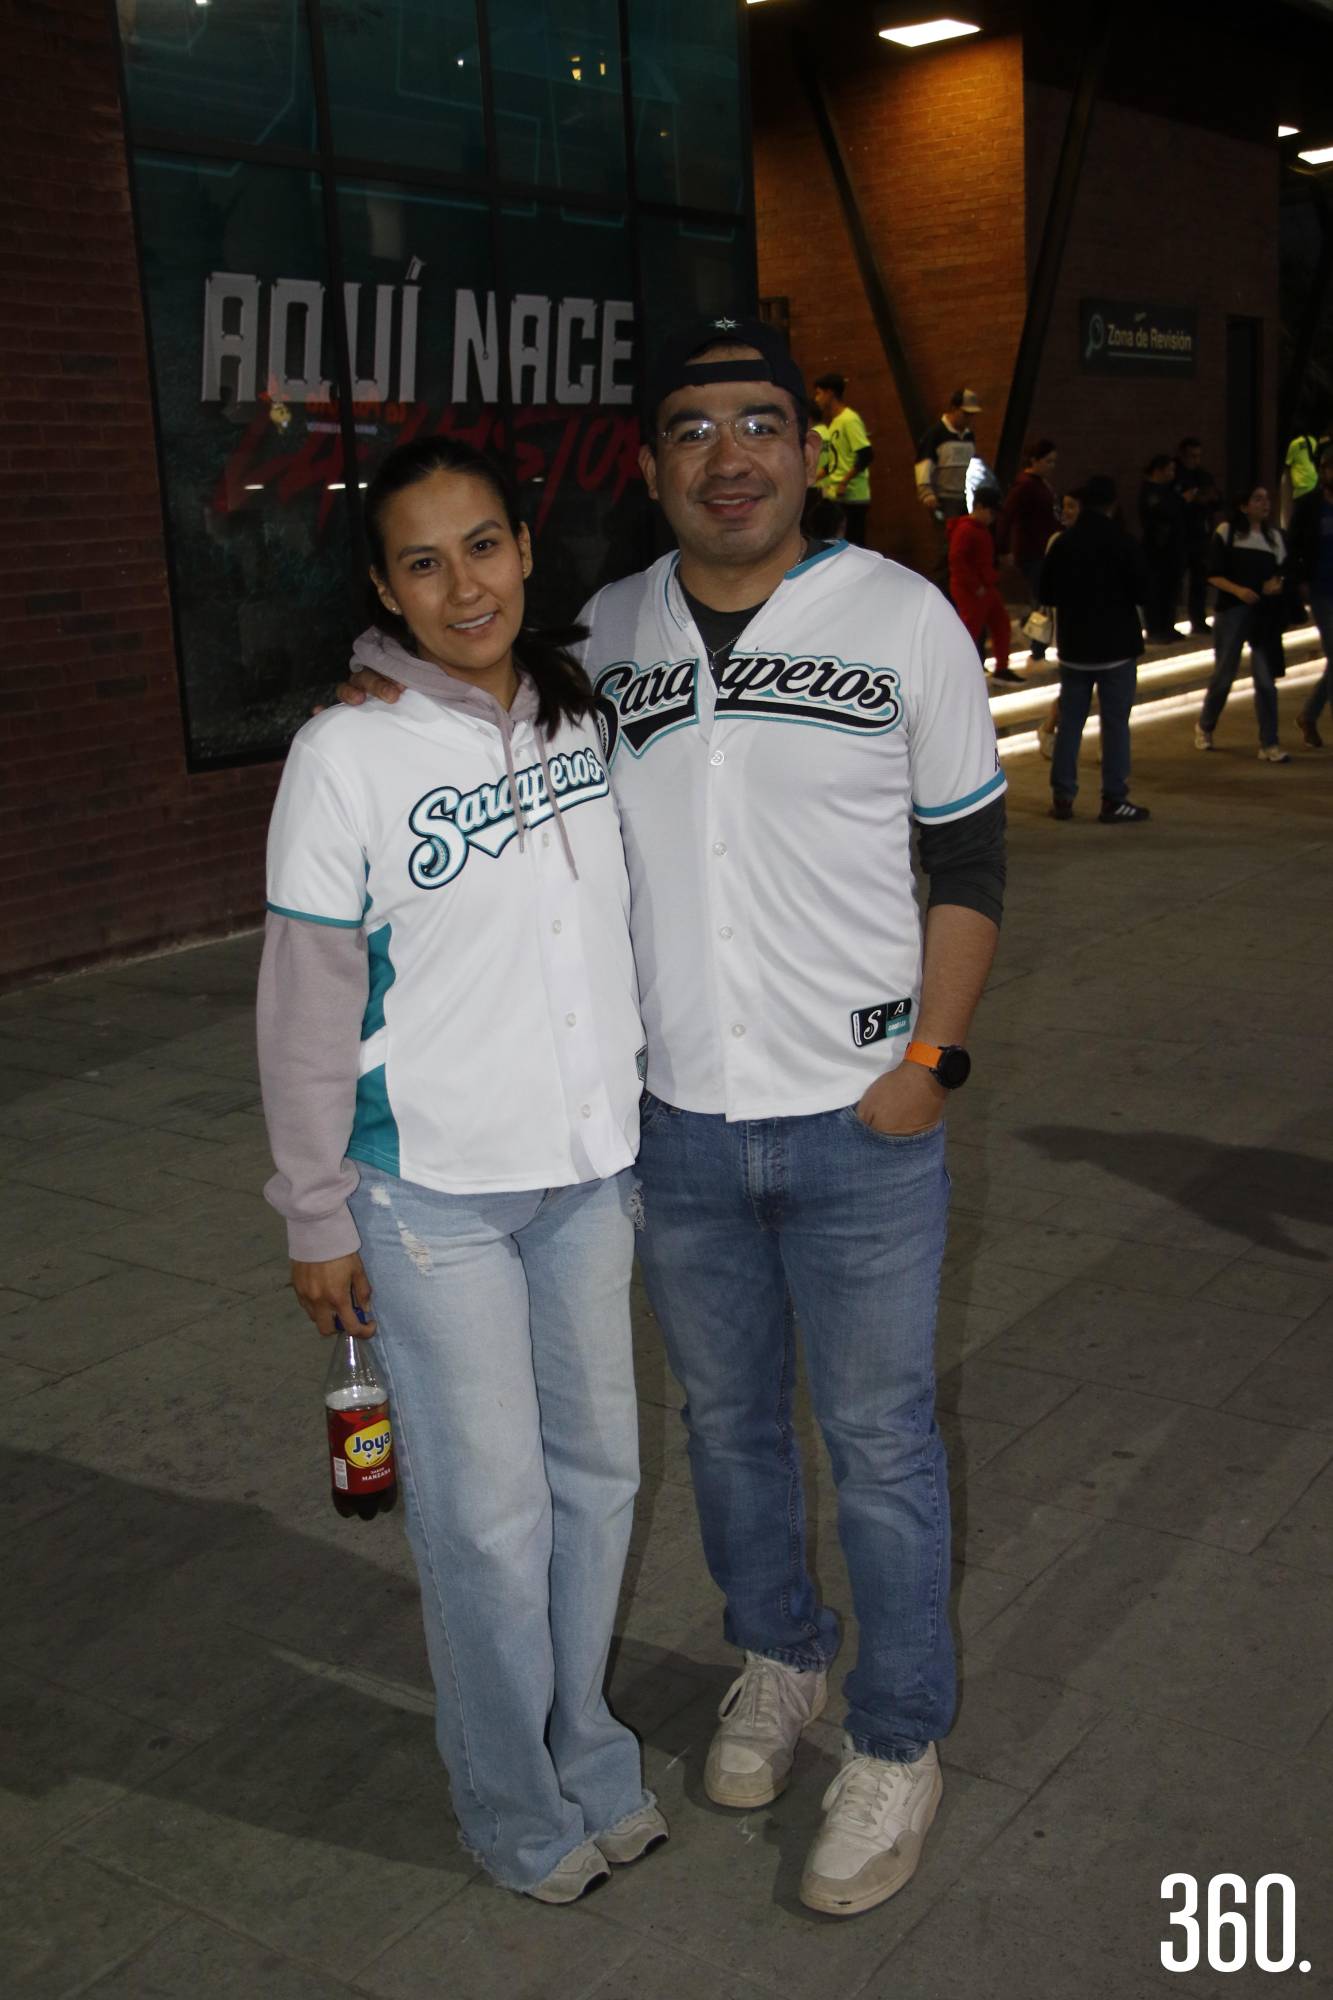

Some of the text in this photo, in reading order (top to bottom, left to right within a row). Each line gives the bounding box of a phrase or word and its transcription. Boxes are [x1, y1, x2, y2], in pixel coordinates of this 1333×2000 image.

[201, 255, 635, 405] AQUÍ NACE
[1107, 324, 1192, 351] Zona de Revisión
[353, 1432, 391, 1454] Joya
